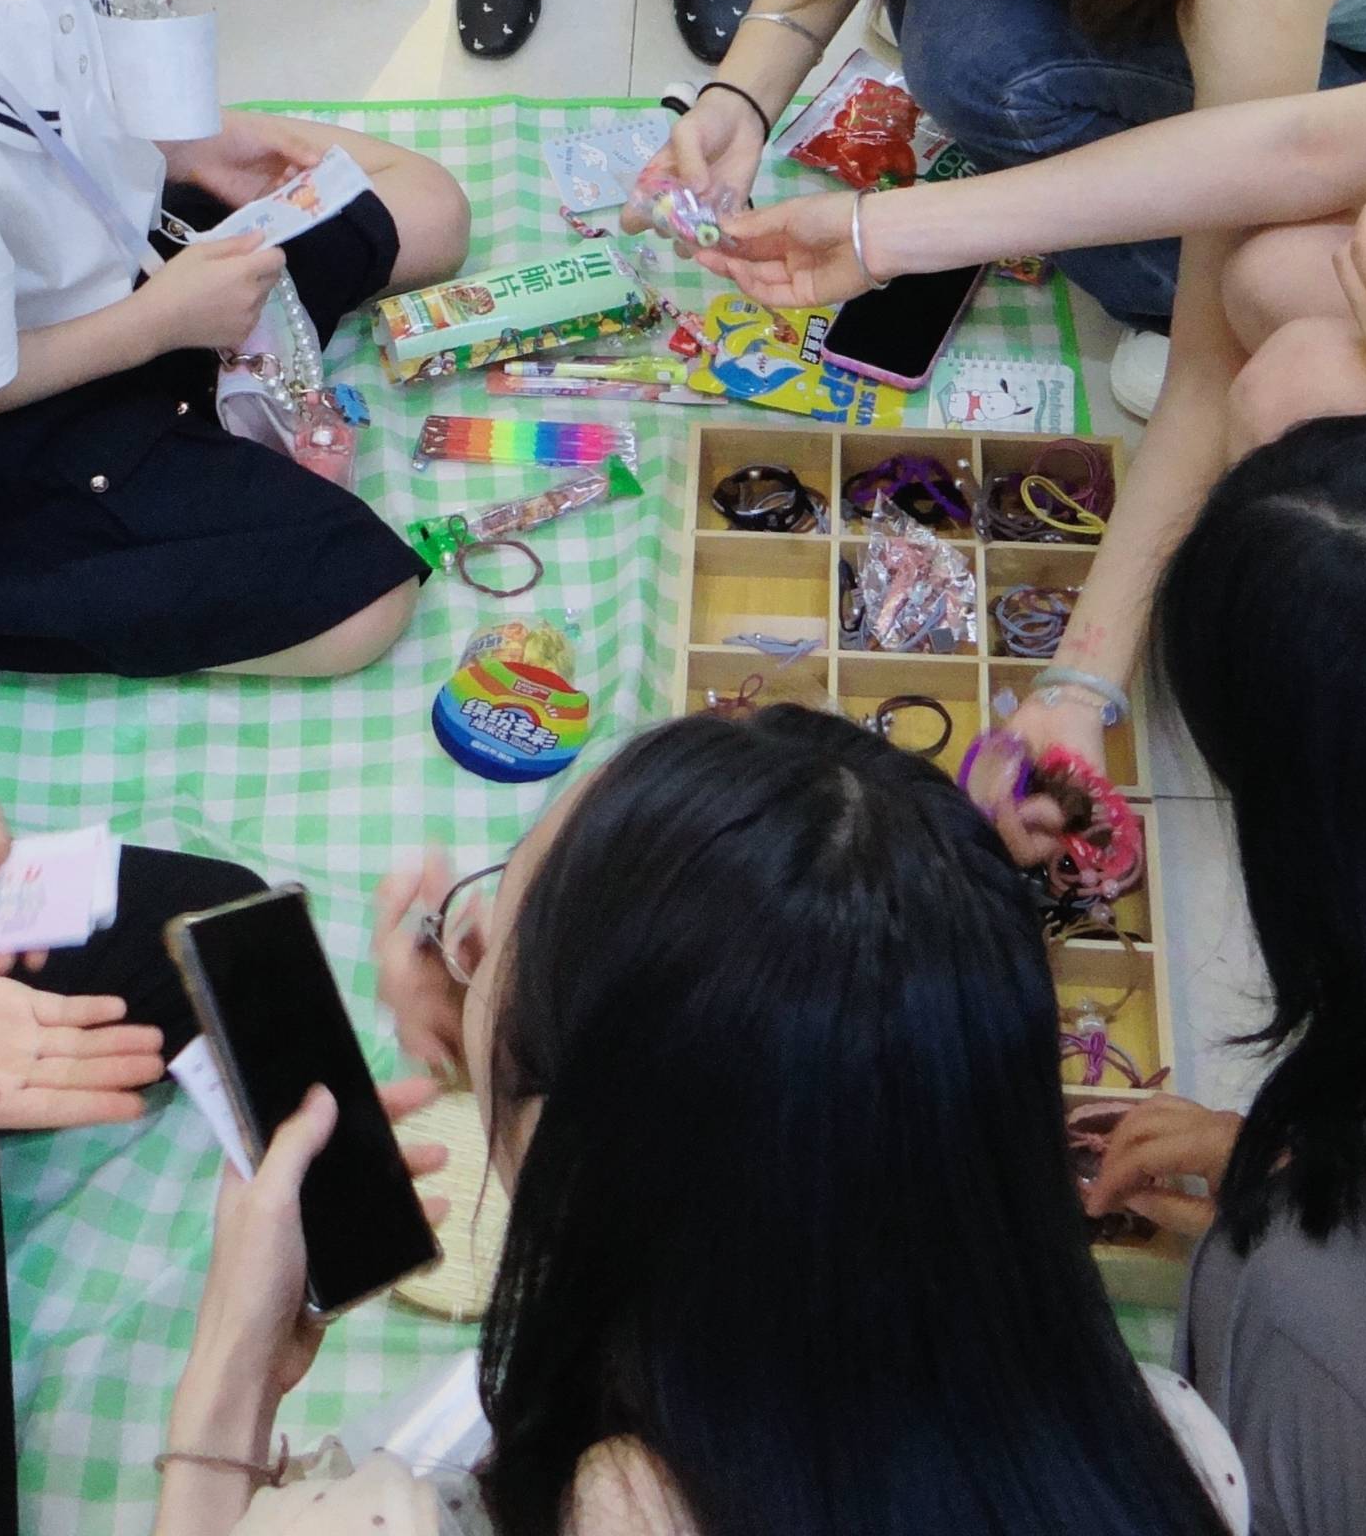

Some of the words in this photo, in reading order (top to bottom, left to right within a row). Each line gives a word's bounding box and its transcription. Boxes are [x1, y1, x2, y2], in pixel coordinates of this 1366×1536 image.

[487, 251, 612, 299] 山药脆片
[462, 699, 560, 749] 缤纷多彩
